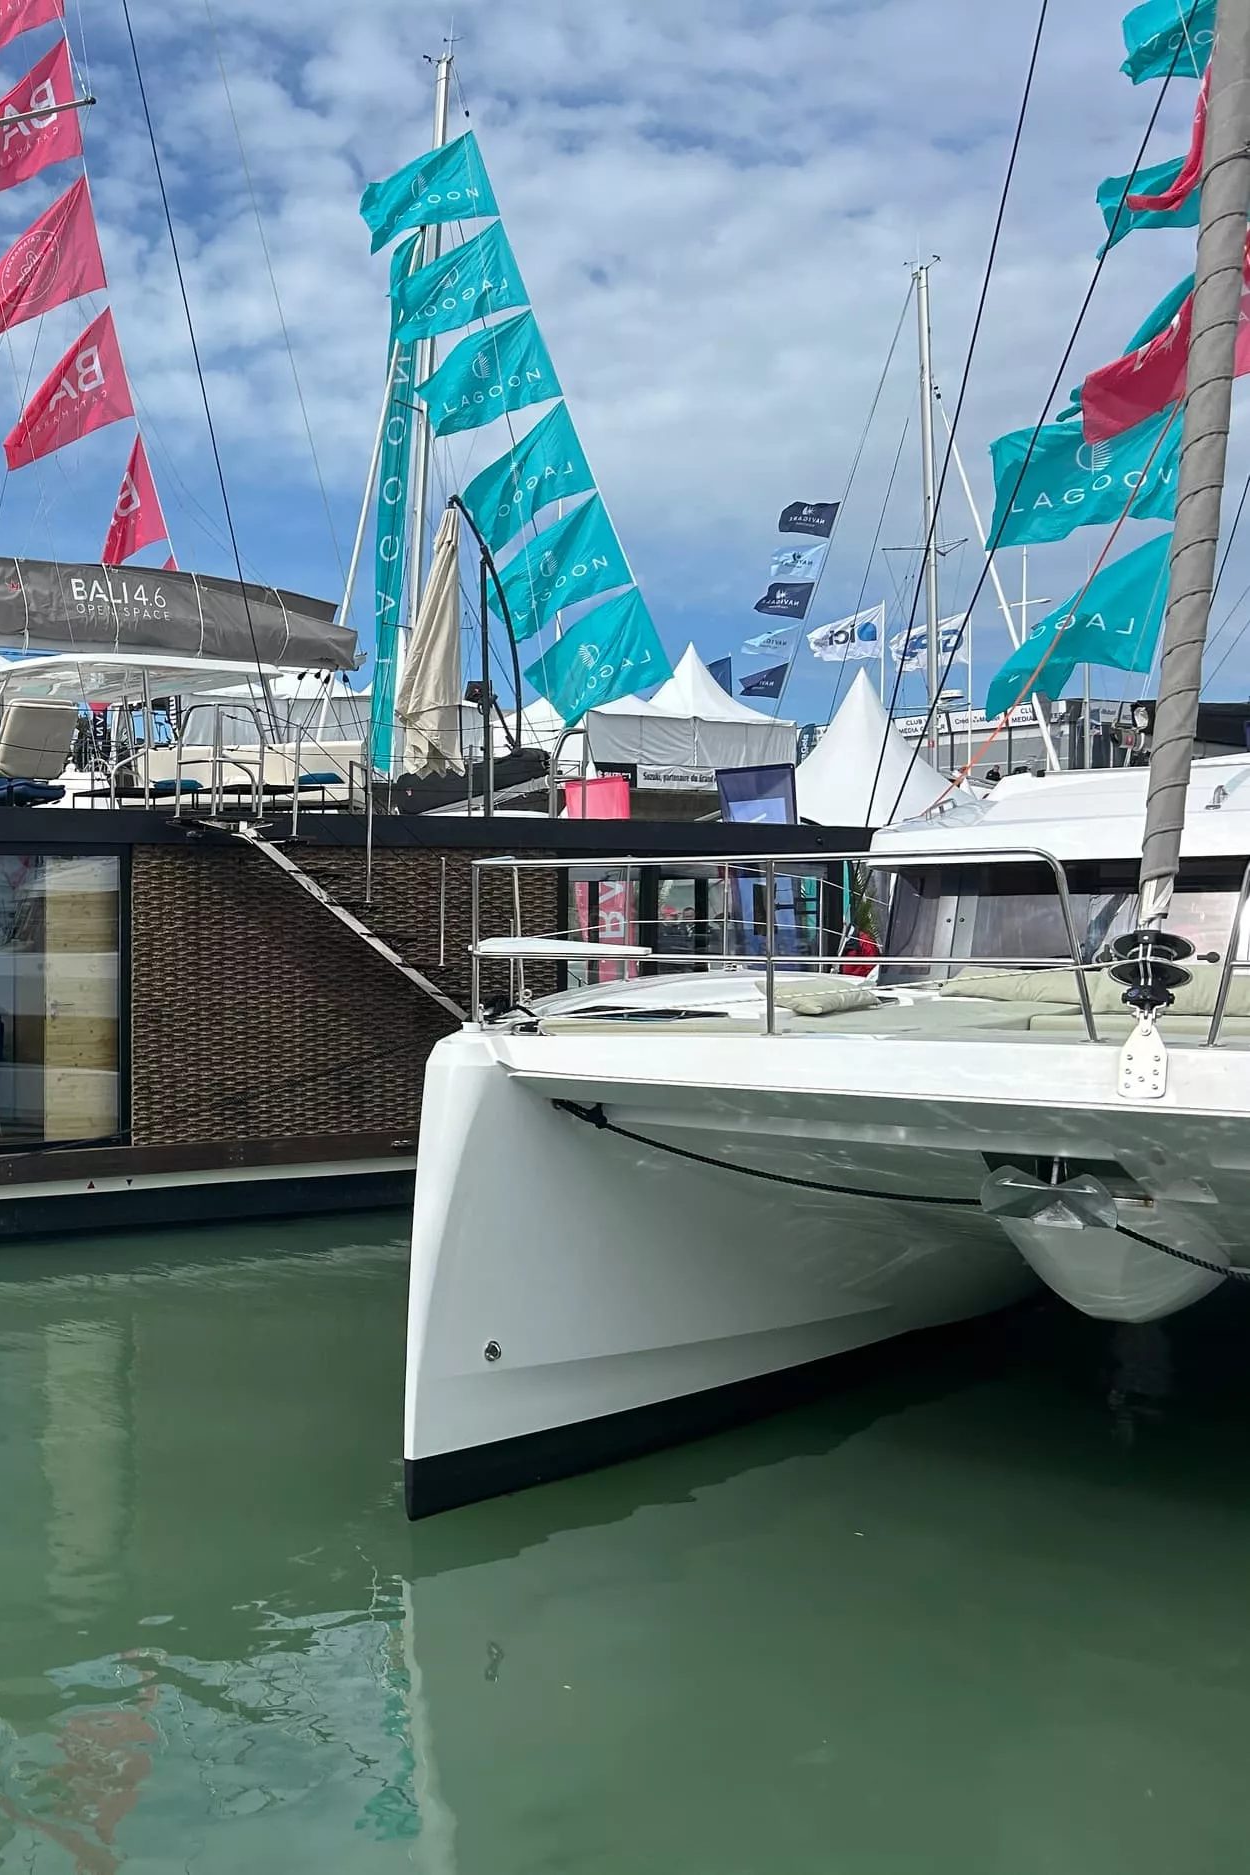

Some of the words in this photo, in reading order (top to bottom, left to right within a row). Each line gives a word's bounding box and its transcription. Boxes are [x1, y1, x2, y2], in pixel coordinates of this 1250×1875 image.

[442, 367, 542, 415] LAGOON
[70, 578, 128, 604] BALI
[133, 584, 167, 608] 4.6
[123, 607, 171, 621] SPACE
